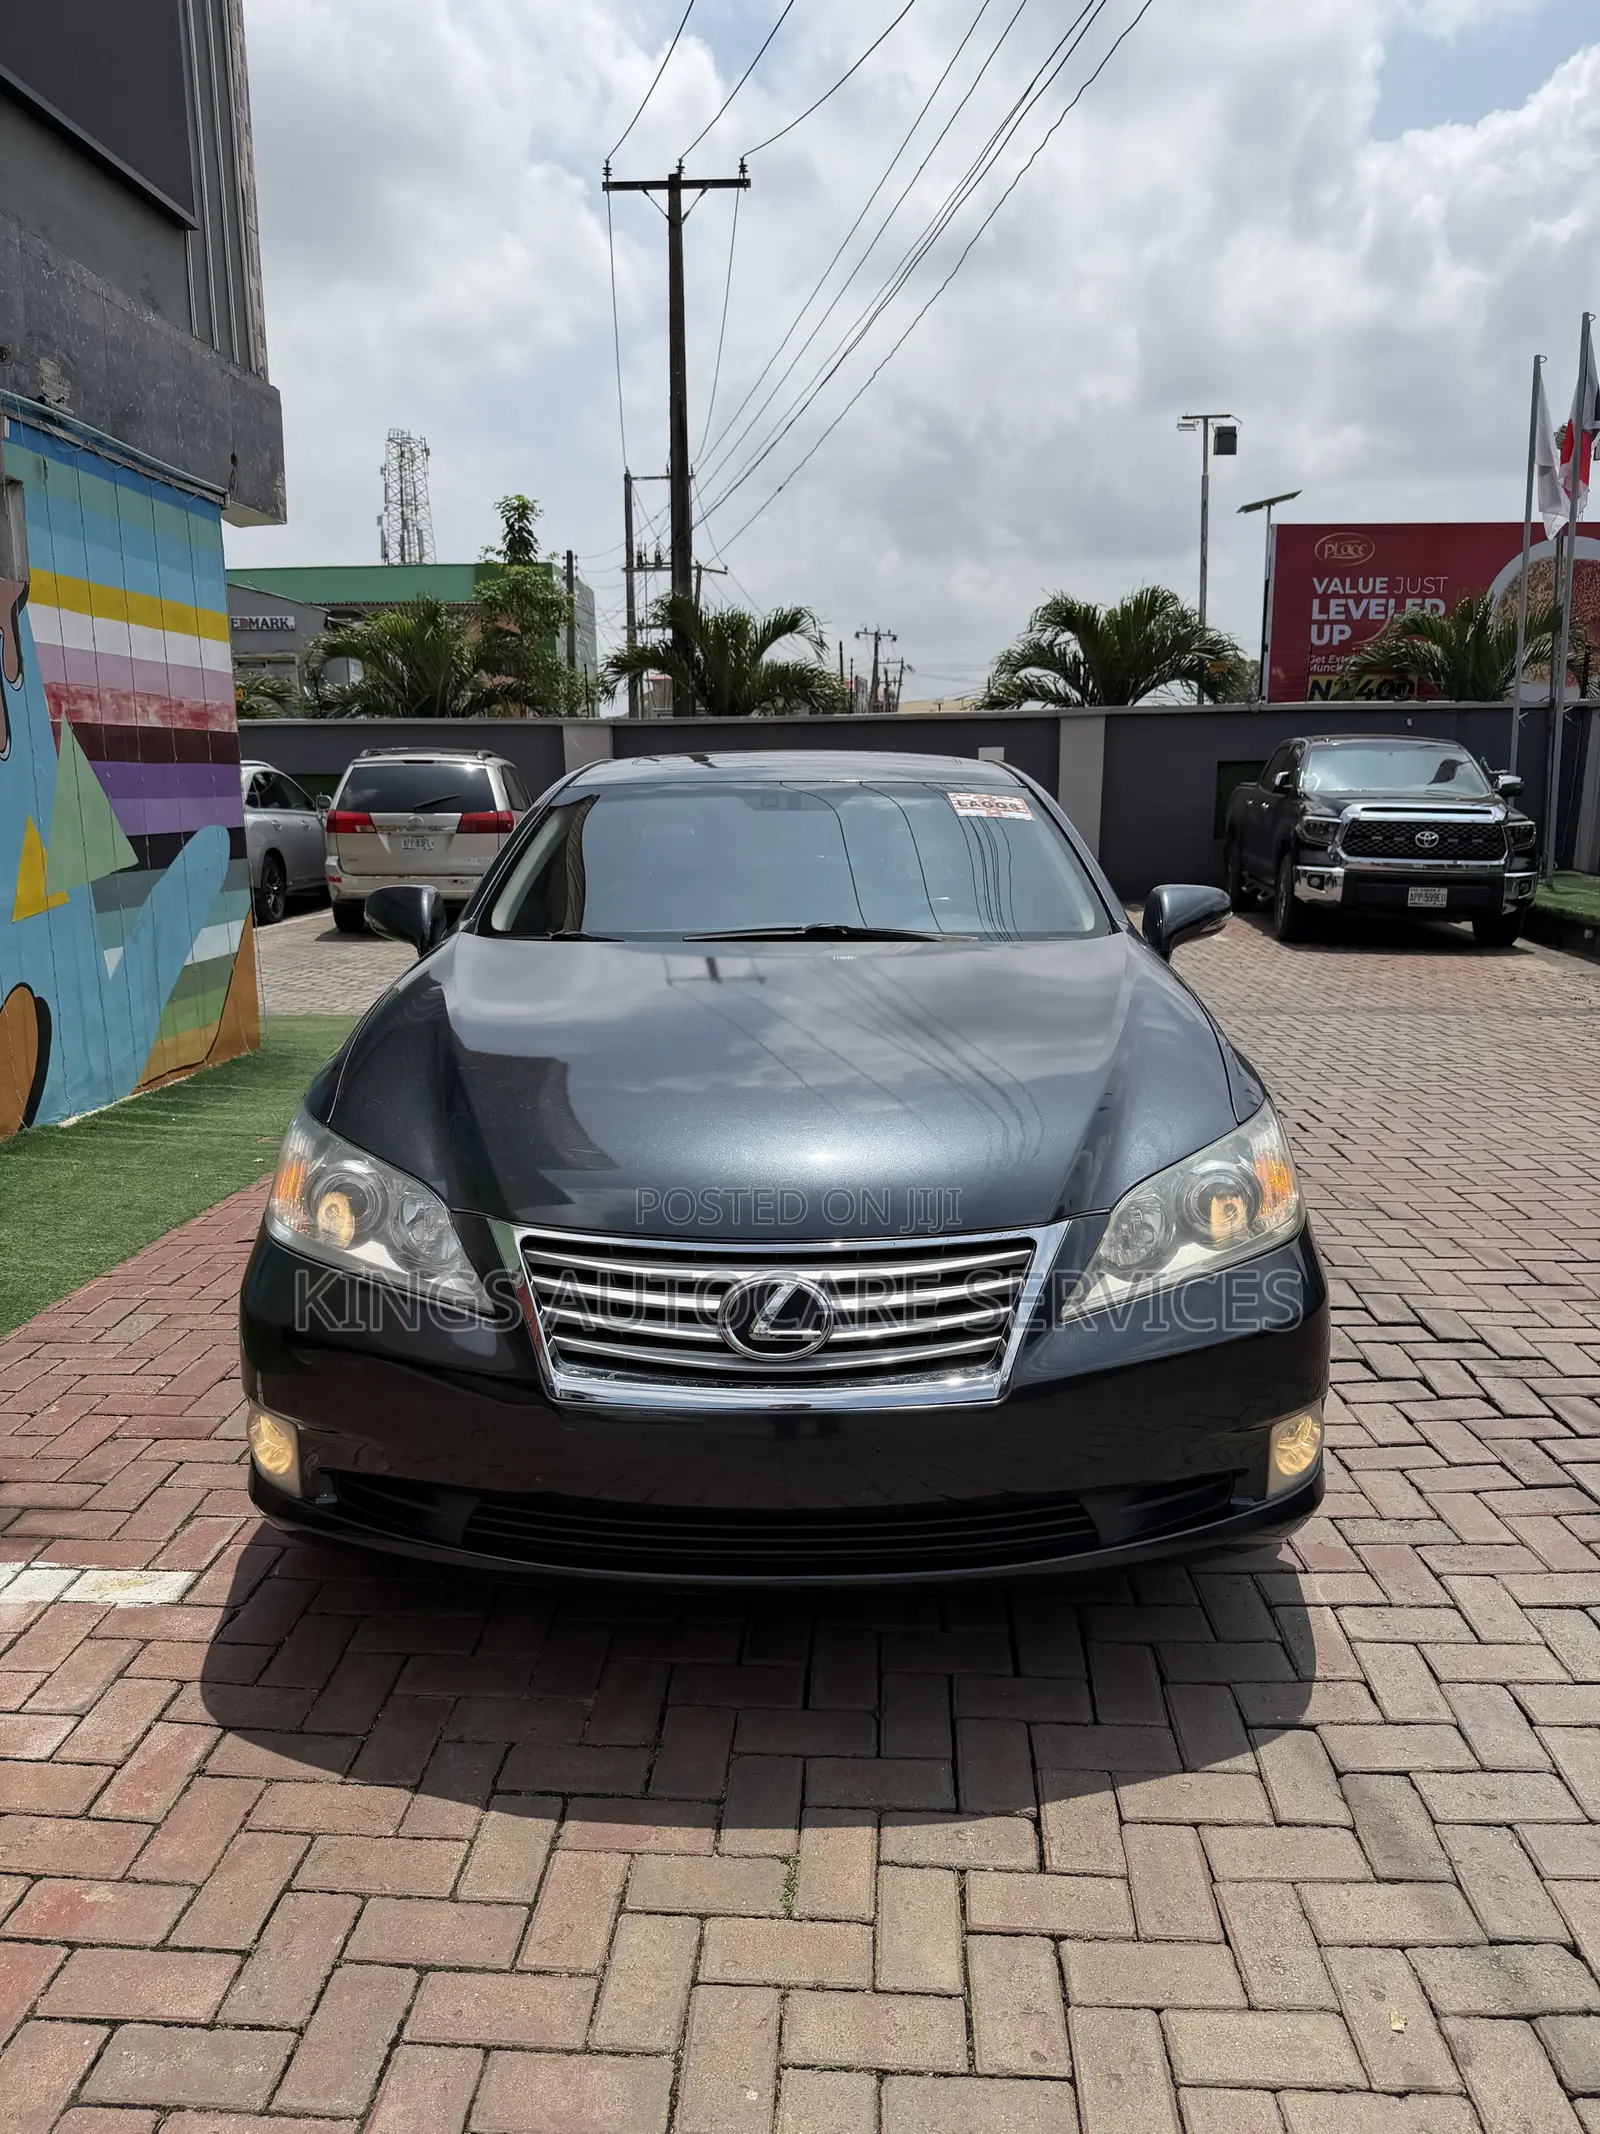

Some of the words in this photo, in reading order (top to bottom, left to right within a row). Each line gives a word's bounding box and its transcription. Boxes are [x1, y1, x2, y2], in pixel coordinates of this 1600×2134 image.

[1312, 577, 1389, 595] VALUE
[1393, 576, 1449, 594] JUST
[1310, 624, 1352, 646] UP
[957, 800, 1020, 811] LAGOS
